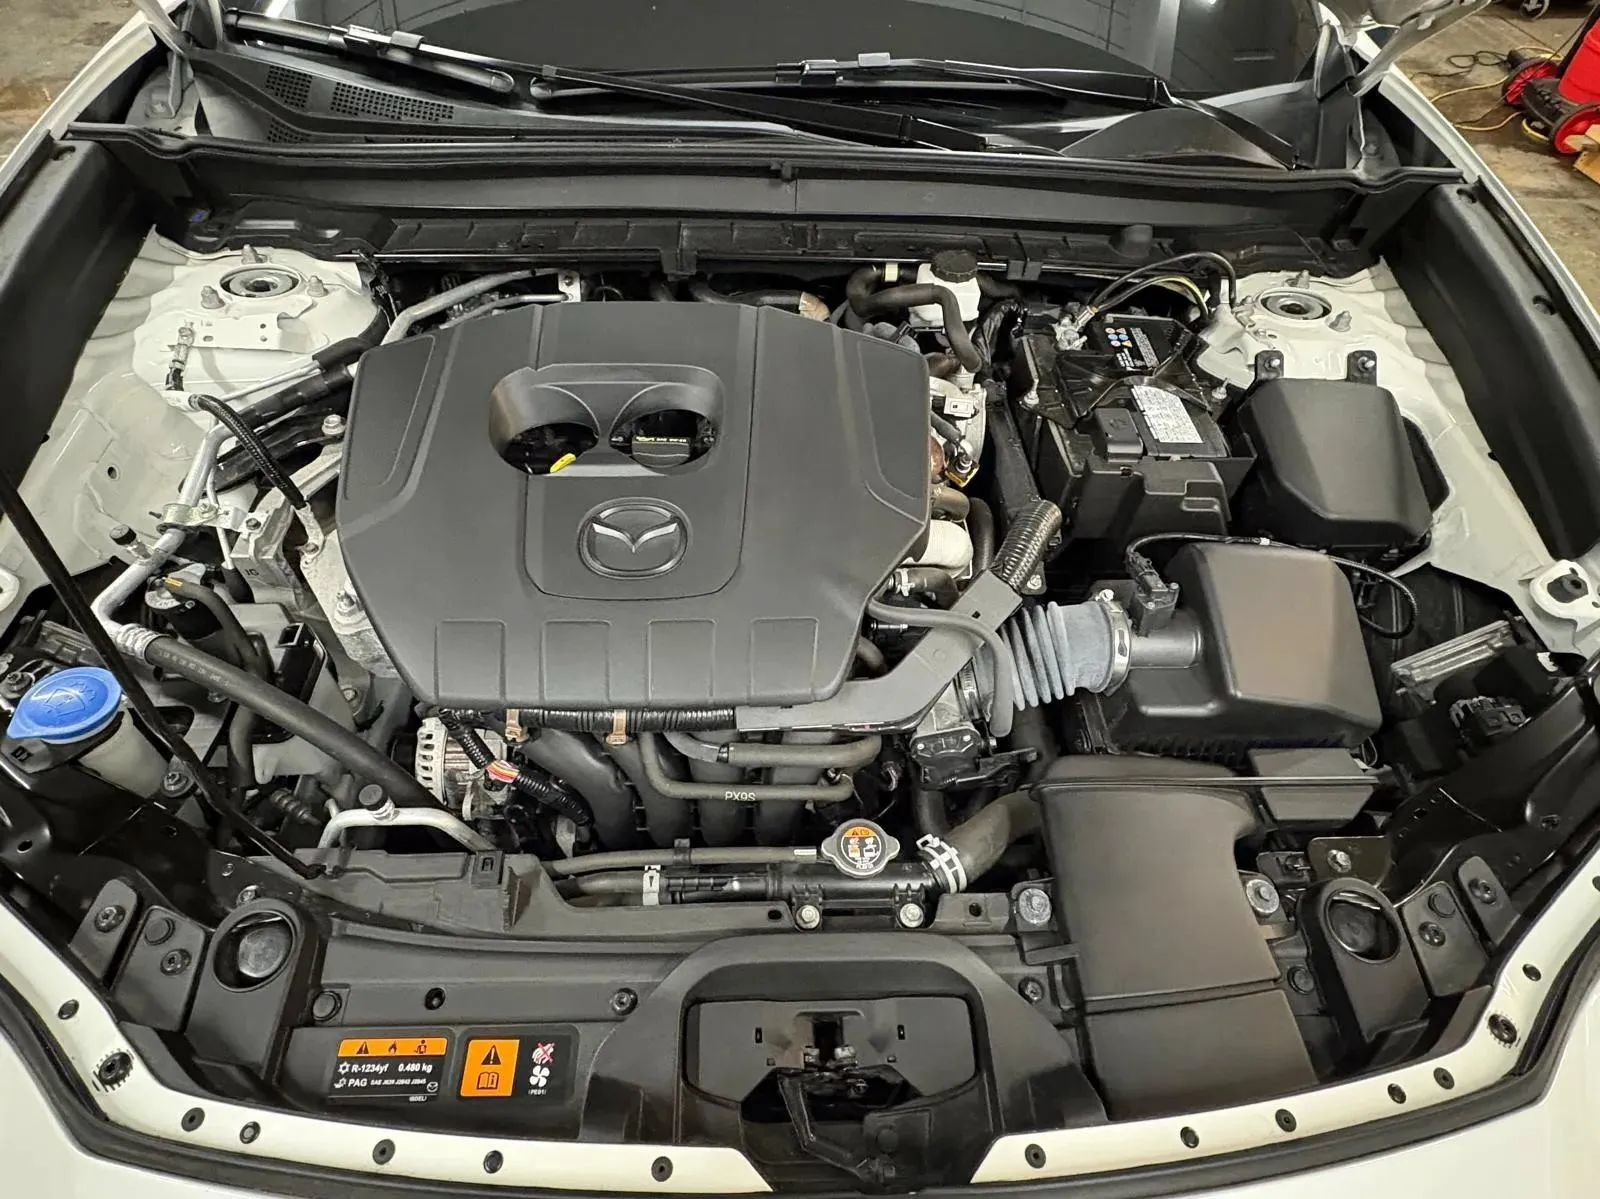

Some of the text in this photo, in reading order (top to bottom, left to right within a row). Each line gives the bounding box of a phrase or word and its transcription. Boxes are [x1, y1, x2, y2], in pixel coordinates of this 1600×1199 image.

[724, 791, 756, 801] PX9S
[351, 1063, 389, 1074] R-1234yf
[421, 1063, 433, 1074] kg
[348, 1078, 368, 1087] PAG
